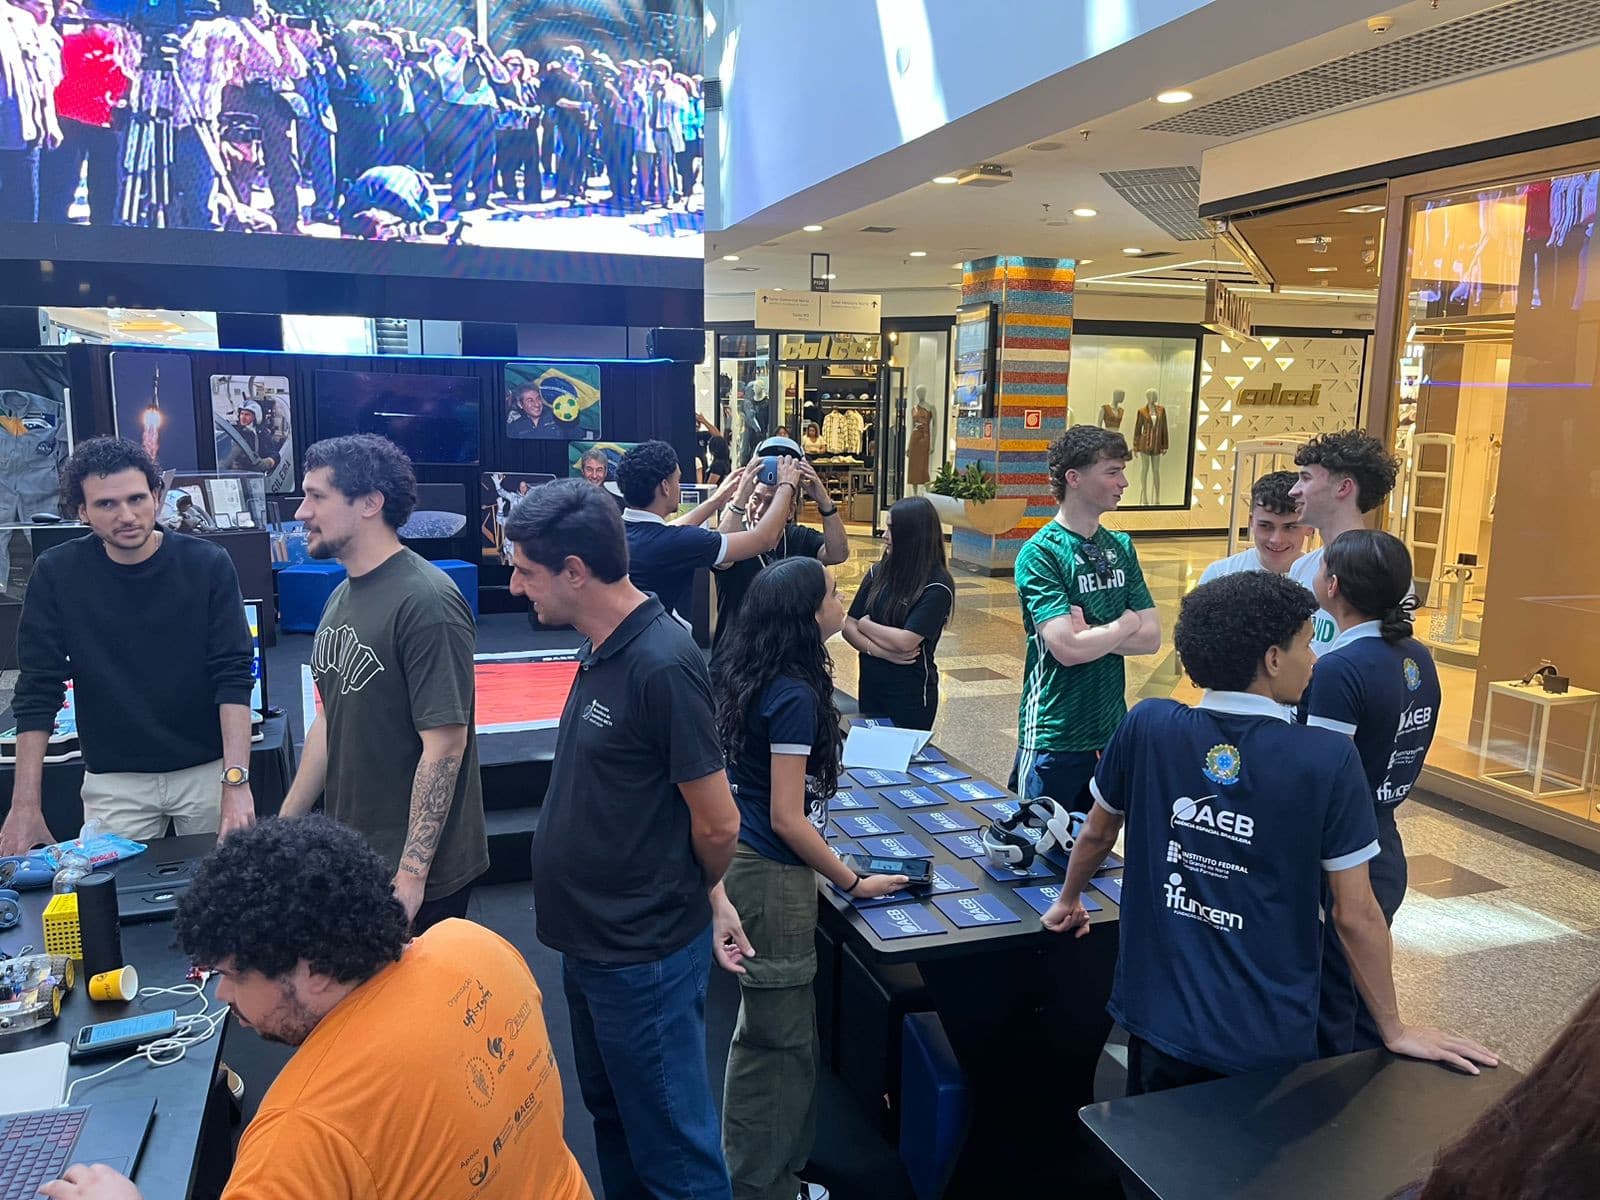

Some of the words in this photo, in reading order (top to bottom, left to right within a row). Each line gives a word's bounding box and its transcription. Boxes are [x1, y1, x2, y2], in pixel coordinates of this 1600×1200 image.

[1236, 383, 1321, 406] colcci
[1194, 804, 1255, 838] AEB
[1182, 851, 1217, 866] INSTITUTO
[1218, 861, 1249, 874] FEDERAL
[886, 909, 910, 927] AEB
[958, 898, 981, 916] AEB
